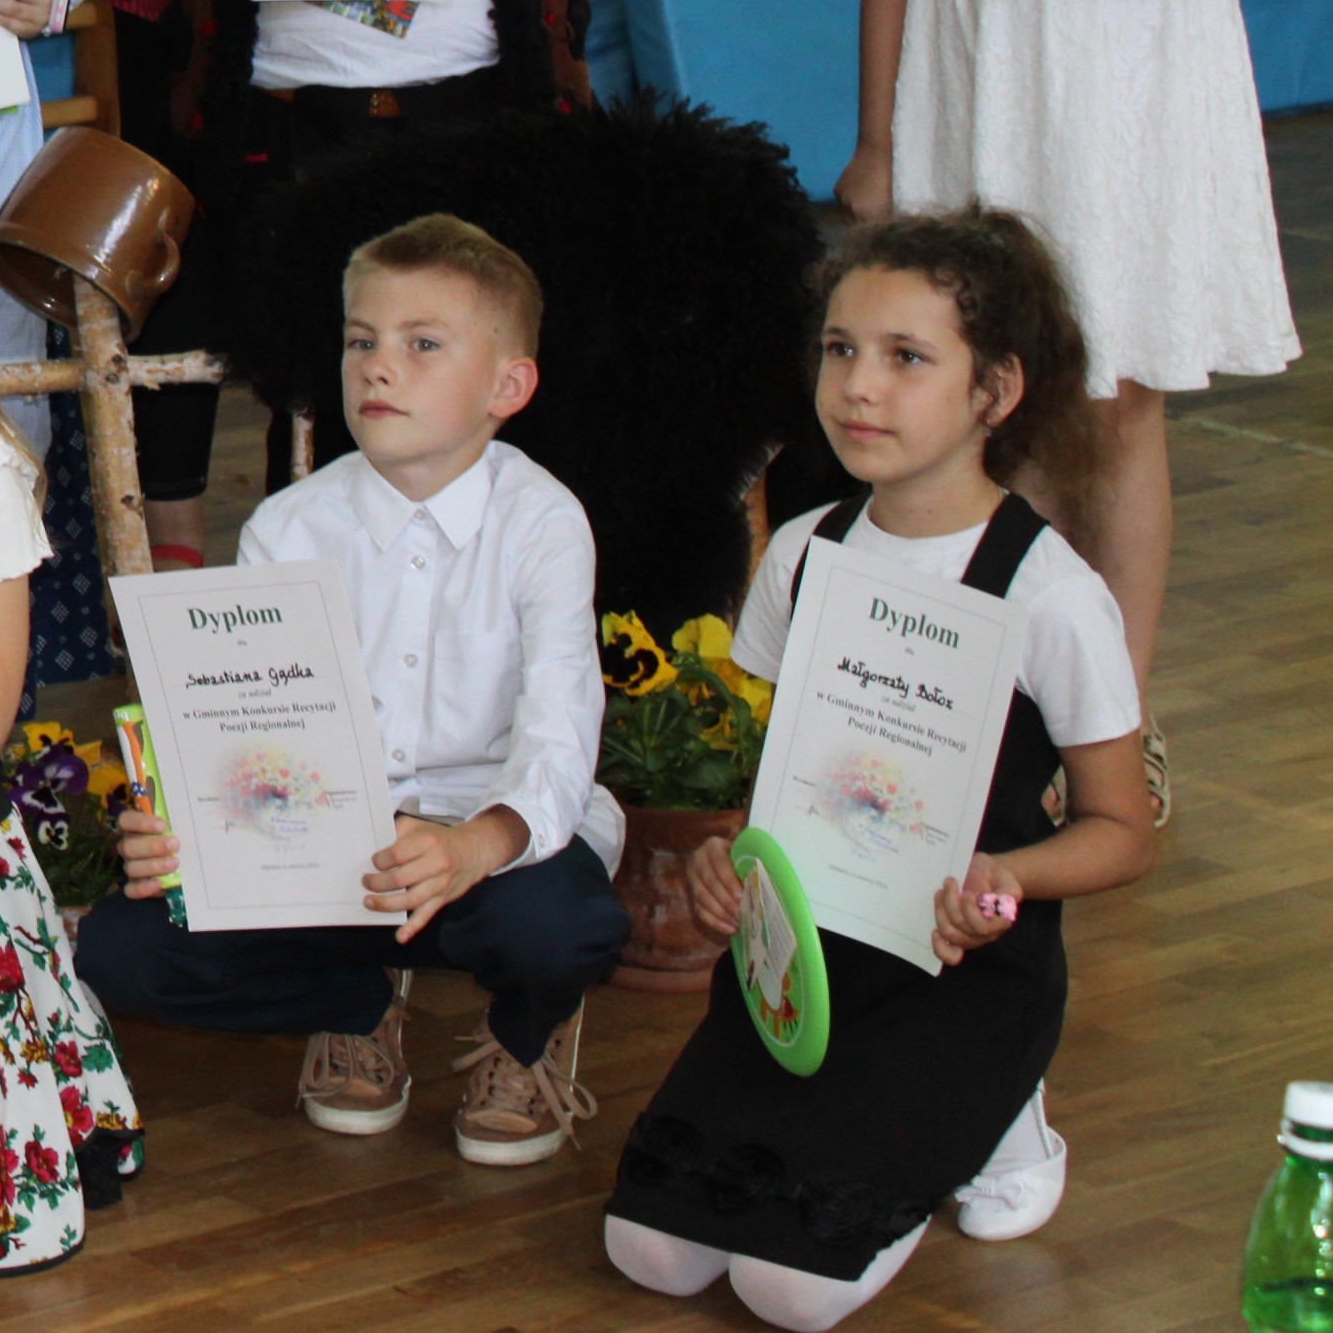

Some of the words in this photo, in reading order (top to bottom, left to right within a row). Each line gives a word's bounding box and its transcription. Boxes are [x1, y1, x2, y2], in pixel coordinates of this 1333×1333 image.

[187, 605, 283, 634] Dyplom
[870, 597, 959, 649] Dyplom
[185, 671, 262, 689] Sebastiana
[837, 657, 910, 699] Małgorzaty
[193, 709, 240, 719] Gminnym
[241, 704, 290, 716] Konkursie
[292, 701, 336, 713] Recytacji
[219, 722, 248, 733] Poezji
[249, 718, 306, 732] Regionalnej
